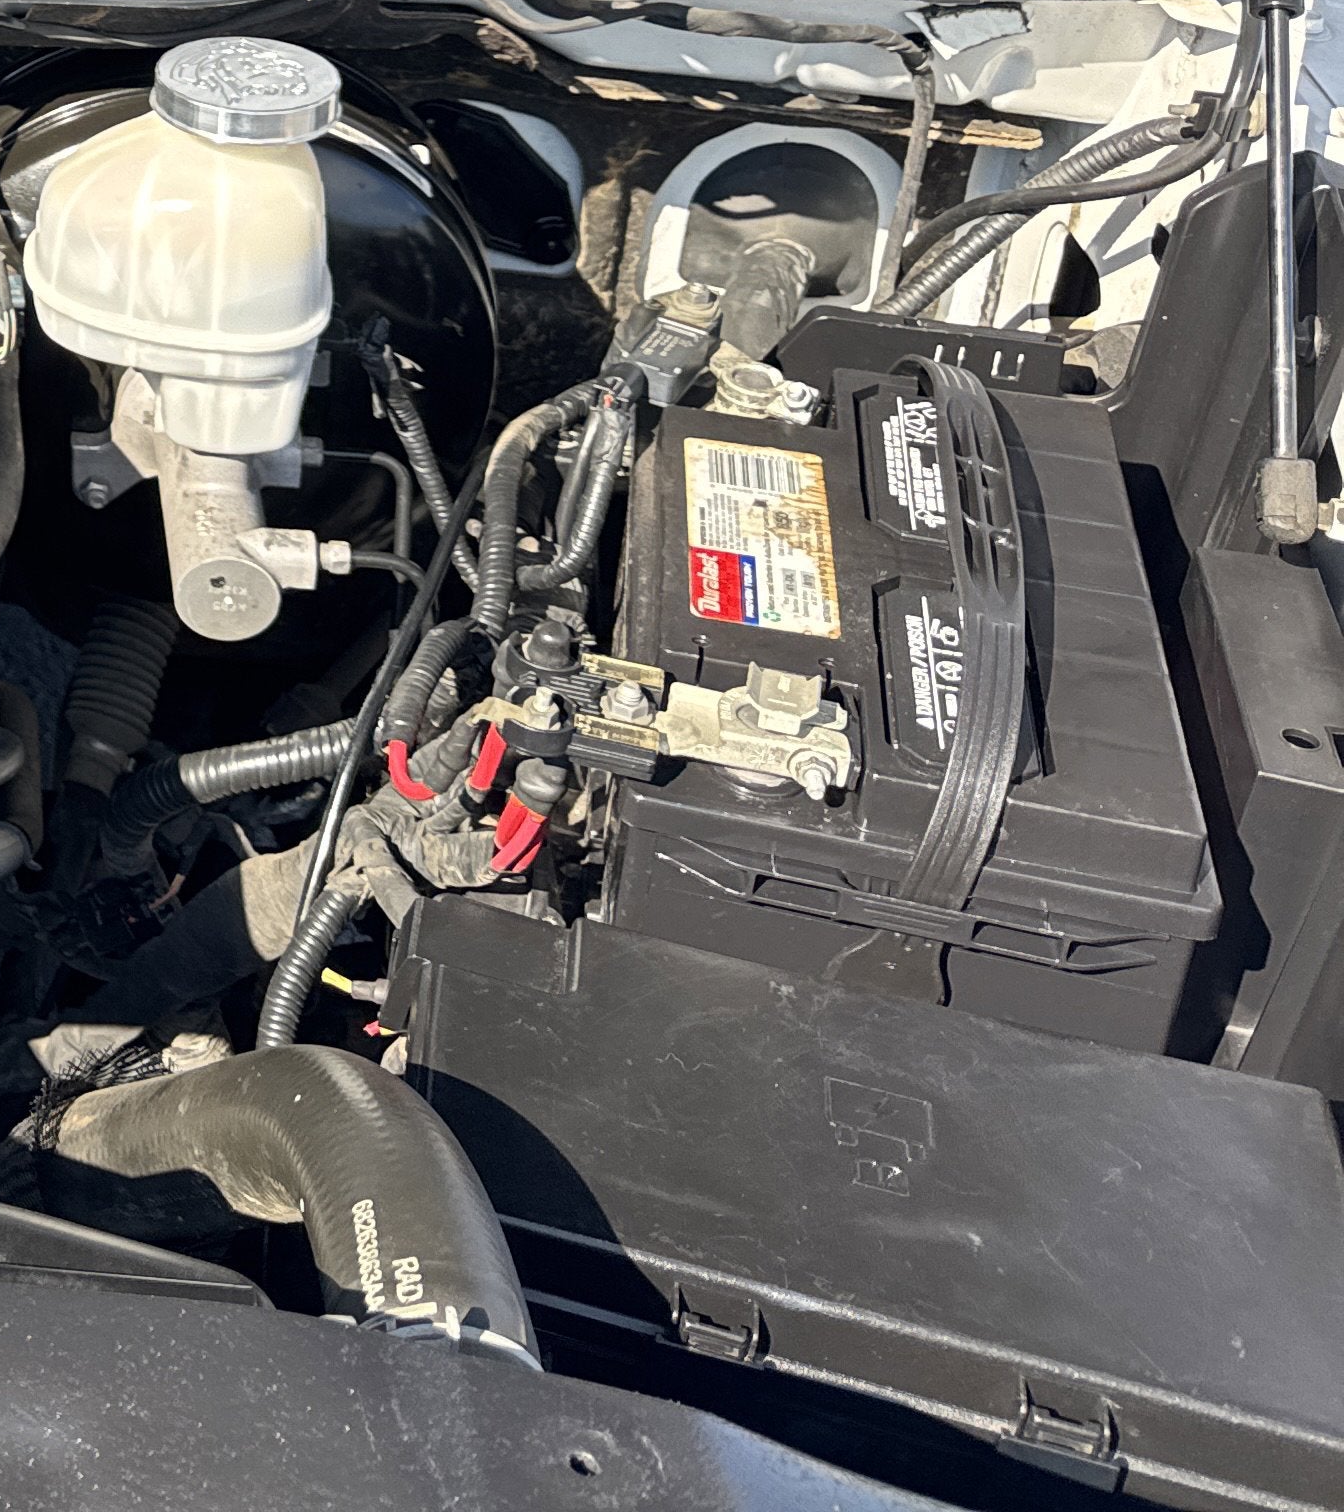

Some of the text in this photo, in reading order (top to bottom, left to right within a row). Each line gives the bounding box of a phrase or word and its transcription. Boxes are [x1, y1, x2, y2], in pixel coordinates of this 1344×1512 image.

[694, 552, 721, 613] Duralast
[351, 1199, 386, 1312] 68263863AA
[391, 1256, 424, 1304] RAD
